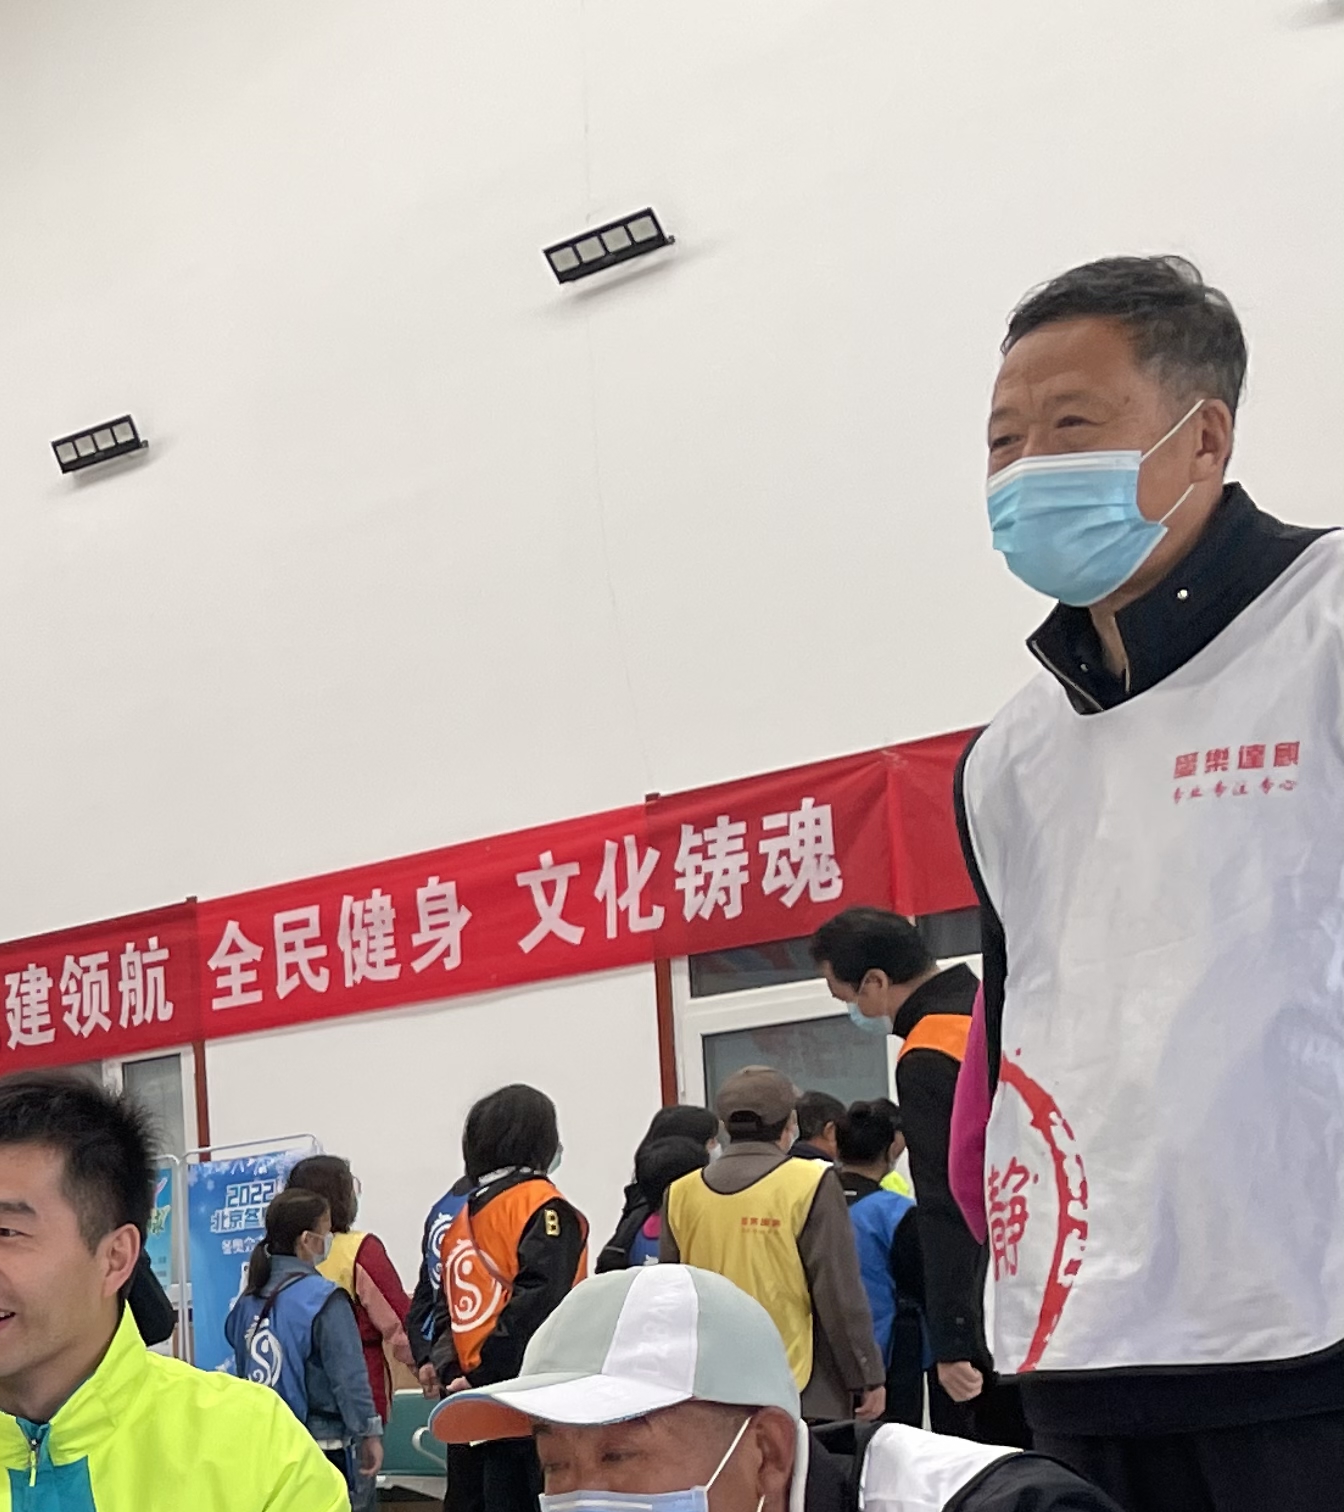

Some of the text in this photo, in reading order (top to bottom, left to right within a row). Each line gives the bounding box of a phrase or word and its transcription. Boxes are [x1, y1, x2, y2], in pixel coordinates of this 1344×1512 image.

[207, 875, 472, 1011] 全民健身
[515, 797, 844, 954] 文化铸魂
[226, 1180, 276, 1208] 2022
[211, 1206, 266, 1233] 北京冬
